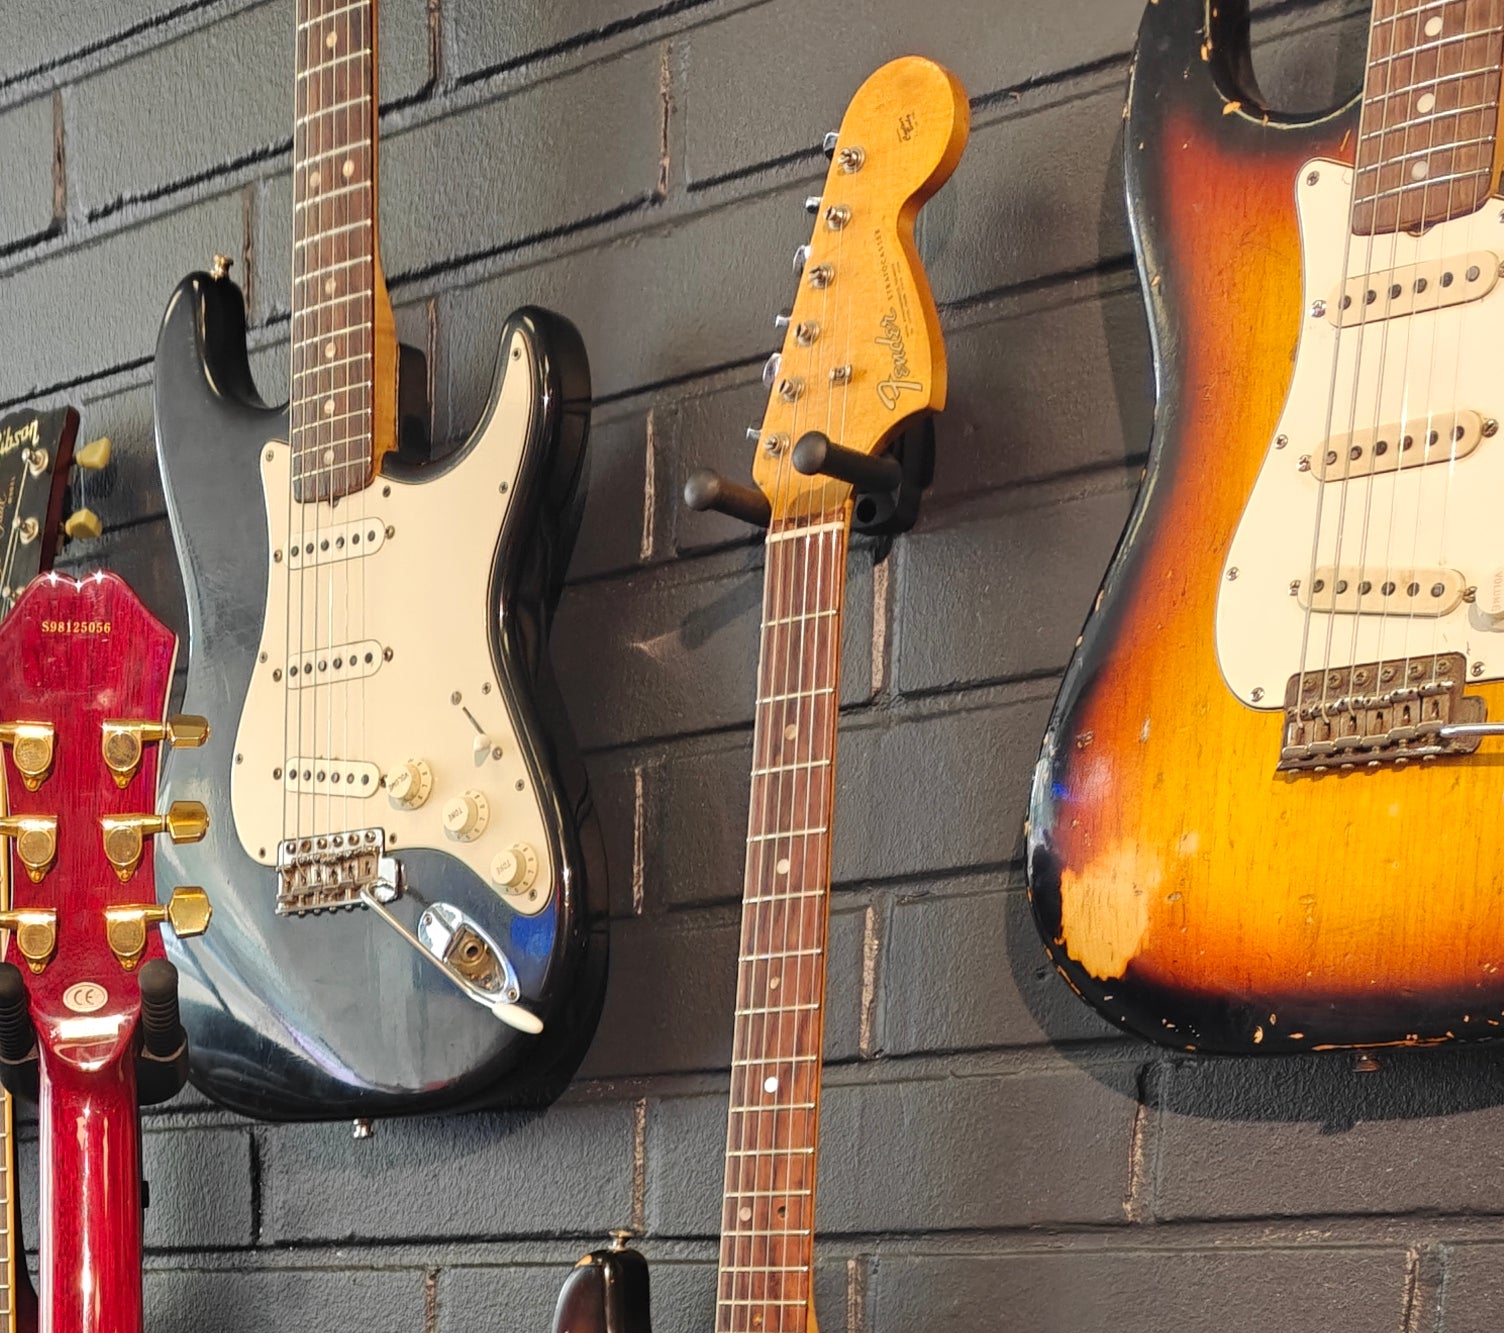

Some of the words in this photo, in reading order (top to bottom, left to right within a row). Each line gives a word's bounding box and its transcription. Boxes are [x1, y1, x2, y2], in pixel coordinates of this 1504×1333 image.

[874, 306, 923, 411] Fender
[1491, 571, 1503, 611] VOLUME
[41, 620, 111, 634] S98125056
[447, 807, 463, 823] TONE
[73, 988, 95, 1006] CE
